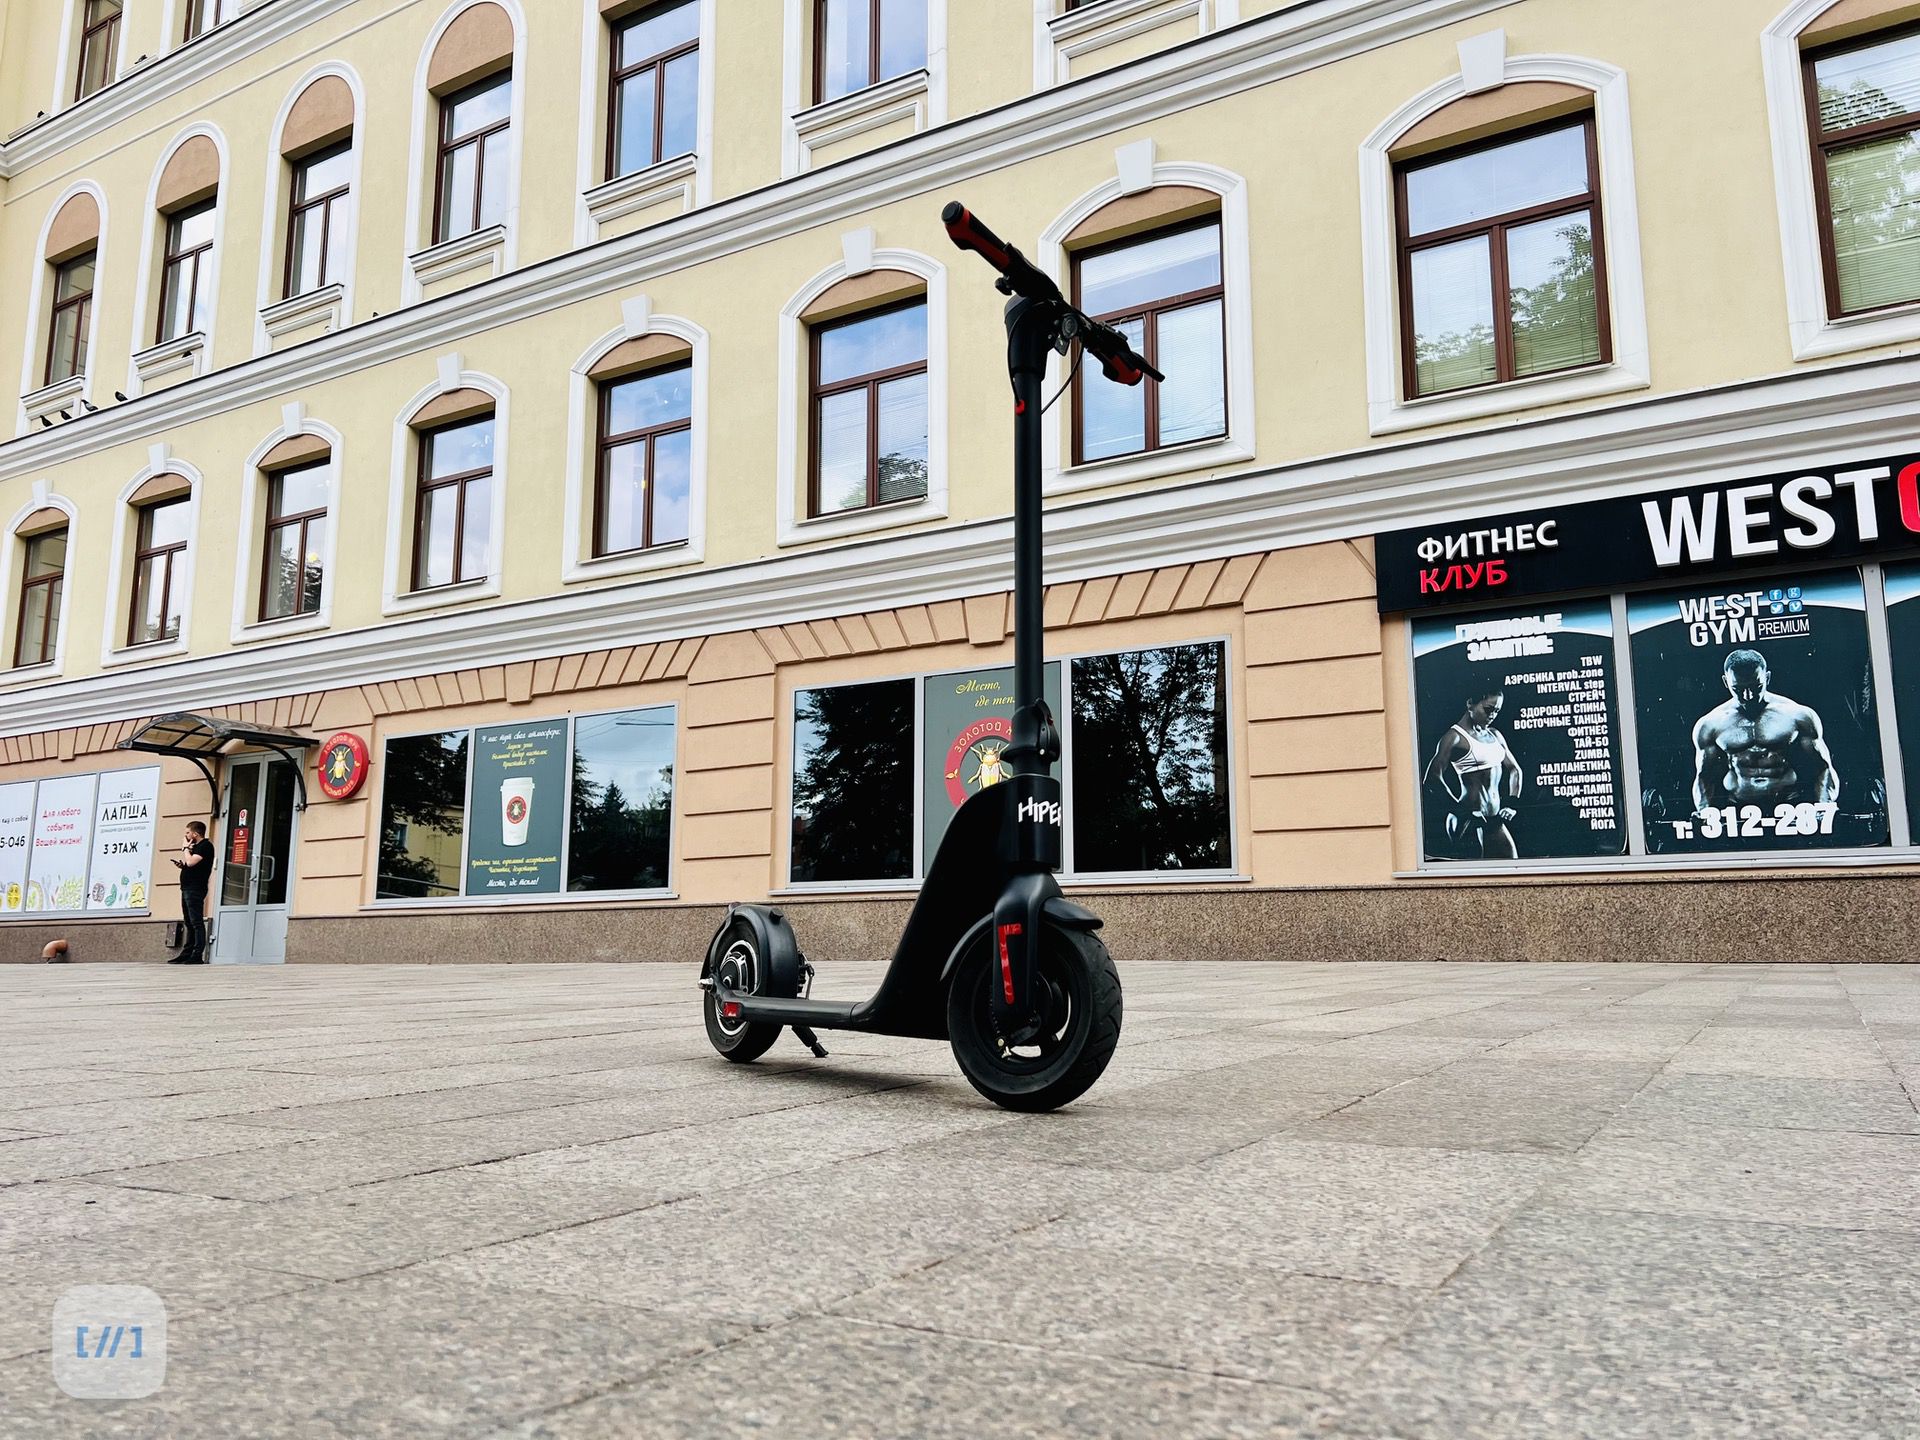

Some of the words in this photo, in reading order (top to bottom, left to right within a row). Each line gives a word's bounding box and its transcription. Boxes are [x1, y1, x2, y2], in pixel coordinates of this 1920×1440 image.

[1641, 465, 1891, 568] WEST
[1417, 519, 1559, 562] ФИТНЕС
[1419, 560, 1509, 594] КЛУБ
[1678, 591, 1764, 624] WEST
[1689, 617, 1756, 647] GYM
[1758, 619, 1810, 636] PREMIUM
[1580, 655, 1603, 668] TBW
[1504, 672, 1555, 686] АЭРОБИКА
[1556, 667, 1604, 685] prob.zone
[956, 679, 1001, 694] Место,
[1537, 682, 1582, 694] INTERVAL
[1584, 679, 1605, 692] step
[1568, 689, 1606, 703] СТРЕЙЧ
[1520, 704, 1571, 719] ЗДОРОВАЯ
[1573, 702, 1607, 715] СПИНА
[1513, 716, 1572, 730] ВОСТОЧНЫЕ
[1573, 713, 1608, 727] ТАНЦЫ
[955, 721, 1002, 753] ЗОЛОТОЙ
[1567, 725, 1608, 738] ФИТНЕС
[1573, 736, 1609, 749] ТАЙ-БО
[1574, 748, 1610, 760] ZUMBA
[1540, 760, 1611, 774] КАЛЛАНЕТИКА
[1536, 775, 1560, 786] СТЕП
[1562, 772, 1612, 786] (силовой)
[119, 791, 134, 799] КАФЕ
[1553, 783, 1613, 797] БОДИ-ПАМП
[1571, 795, 1614, 808] ФИТБОЛ
[42, 809, 55, 819] Для
[57, 807, 81, 817] любого
[102, 804, 148, 821] ЛАПША
[1018, 796, 1061, 827] HIPE
[1579, 807, 1615, 819] AFRIKA
[46, 823, 74, 832] события
[1590, 818, 1616, 830] ЙОГА
[1700, 802, 1838, 839] 312-287
[36, 837, 57, 847] Вашей
[60, 835, 82, 845] жизни!
[103, 843, 109, 855] 3
[111, 841, 139, 854] ЭТАЖ
